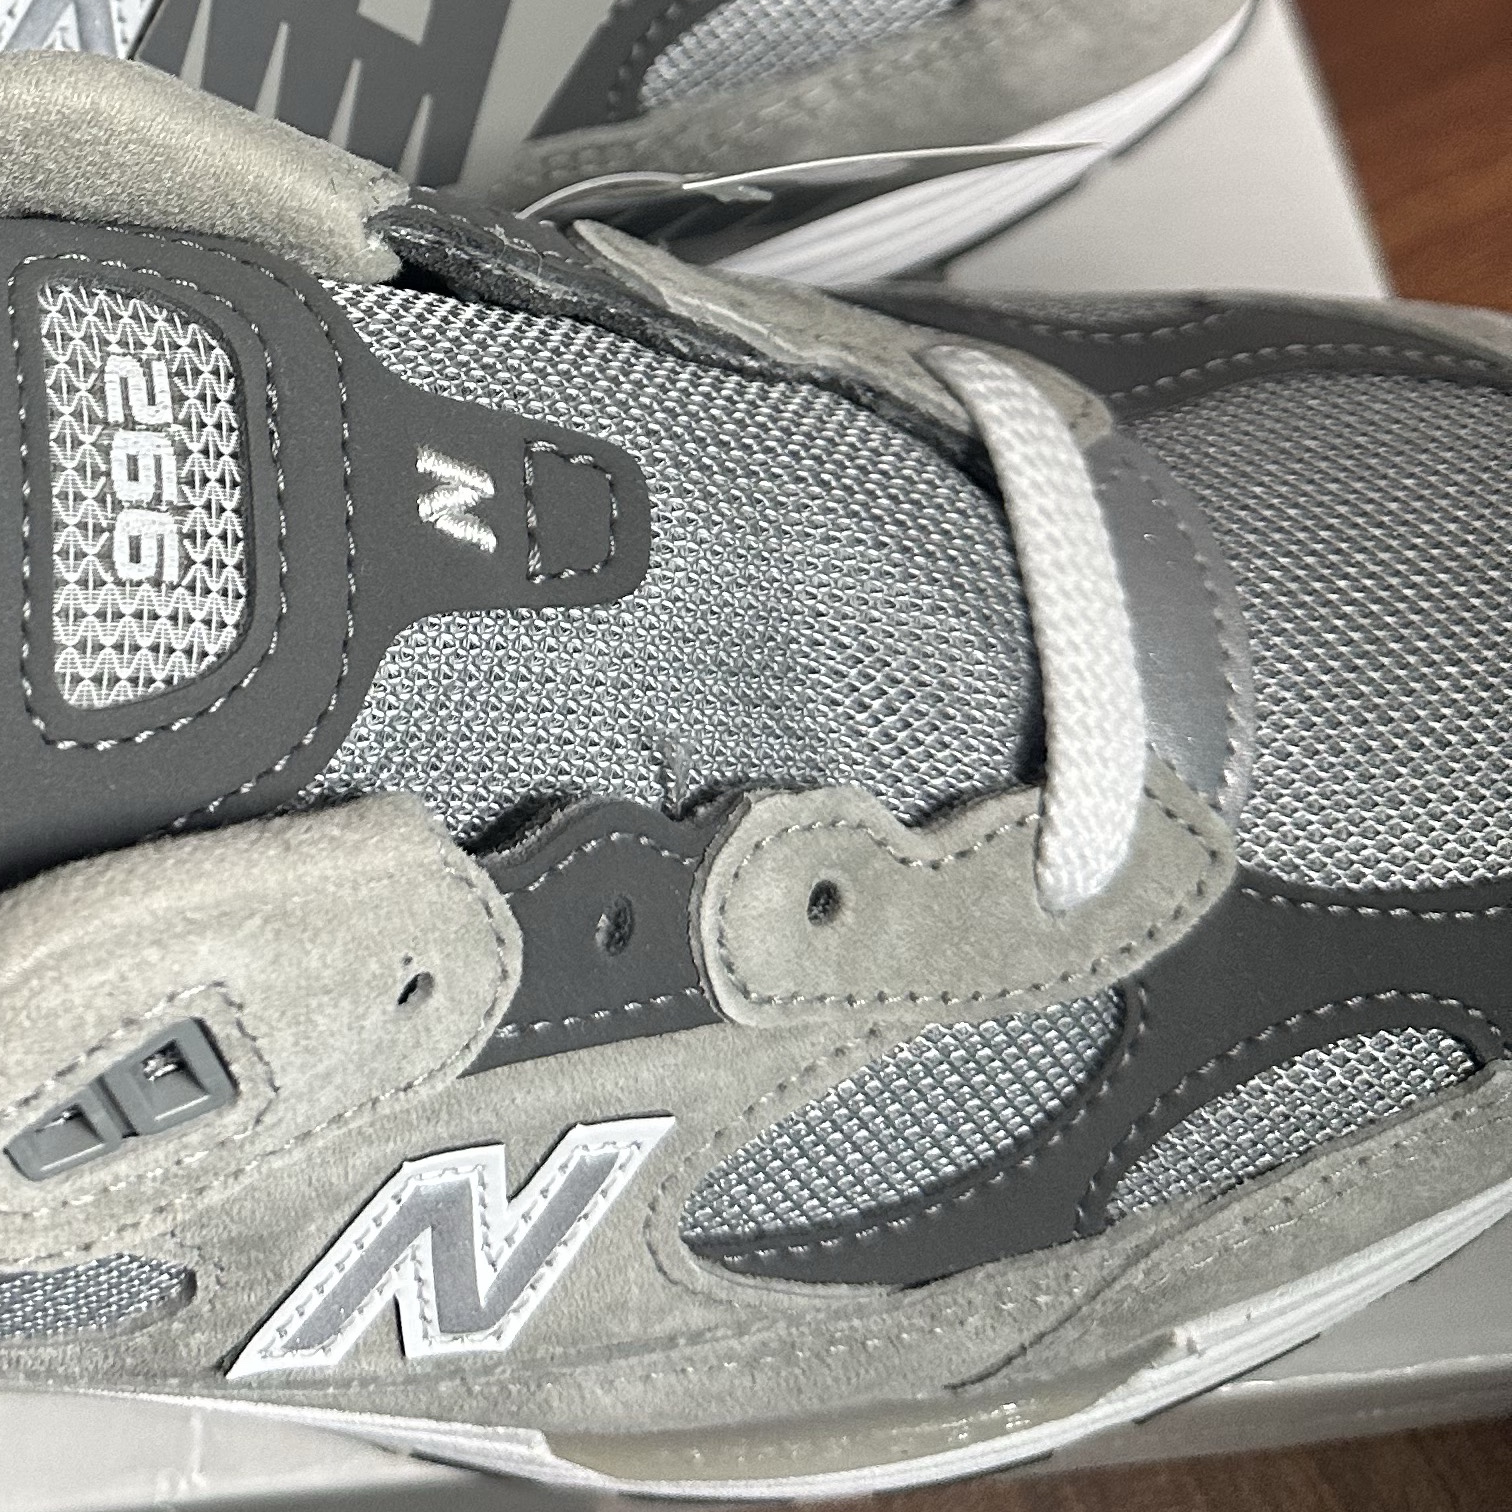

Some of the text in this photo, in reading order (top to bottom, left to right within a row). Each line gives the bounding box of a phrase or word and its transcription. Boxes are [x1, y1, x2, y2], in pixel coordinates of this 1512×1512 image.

[103, 354, 185, 585] 992
[414, 443, 498, 554] N
[223, 1115, 676, 1380] N
